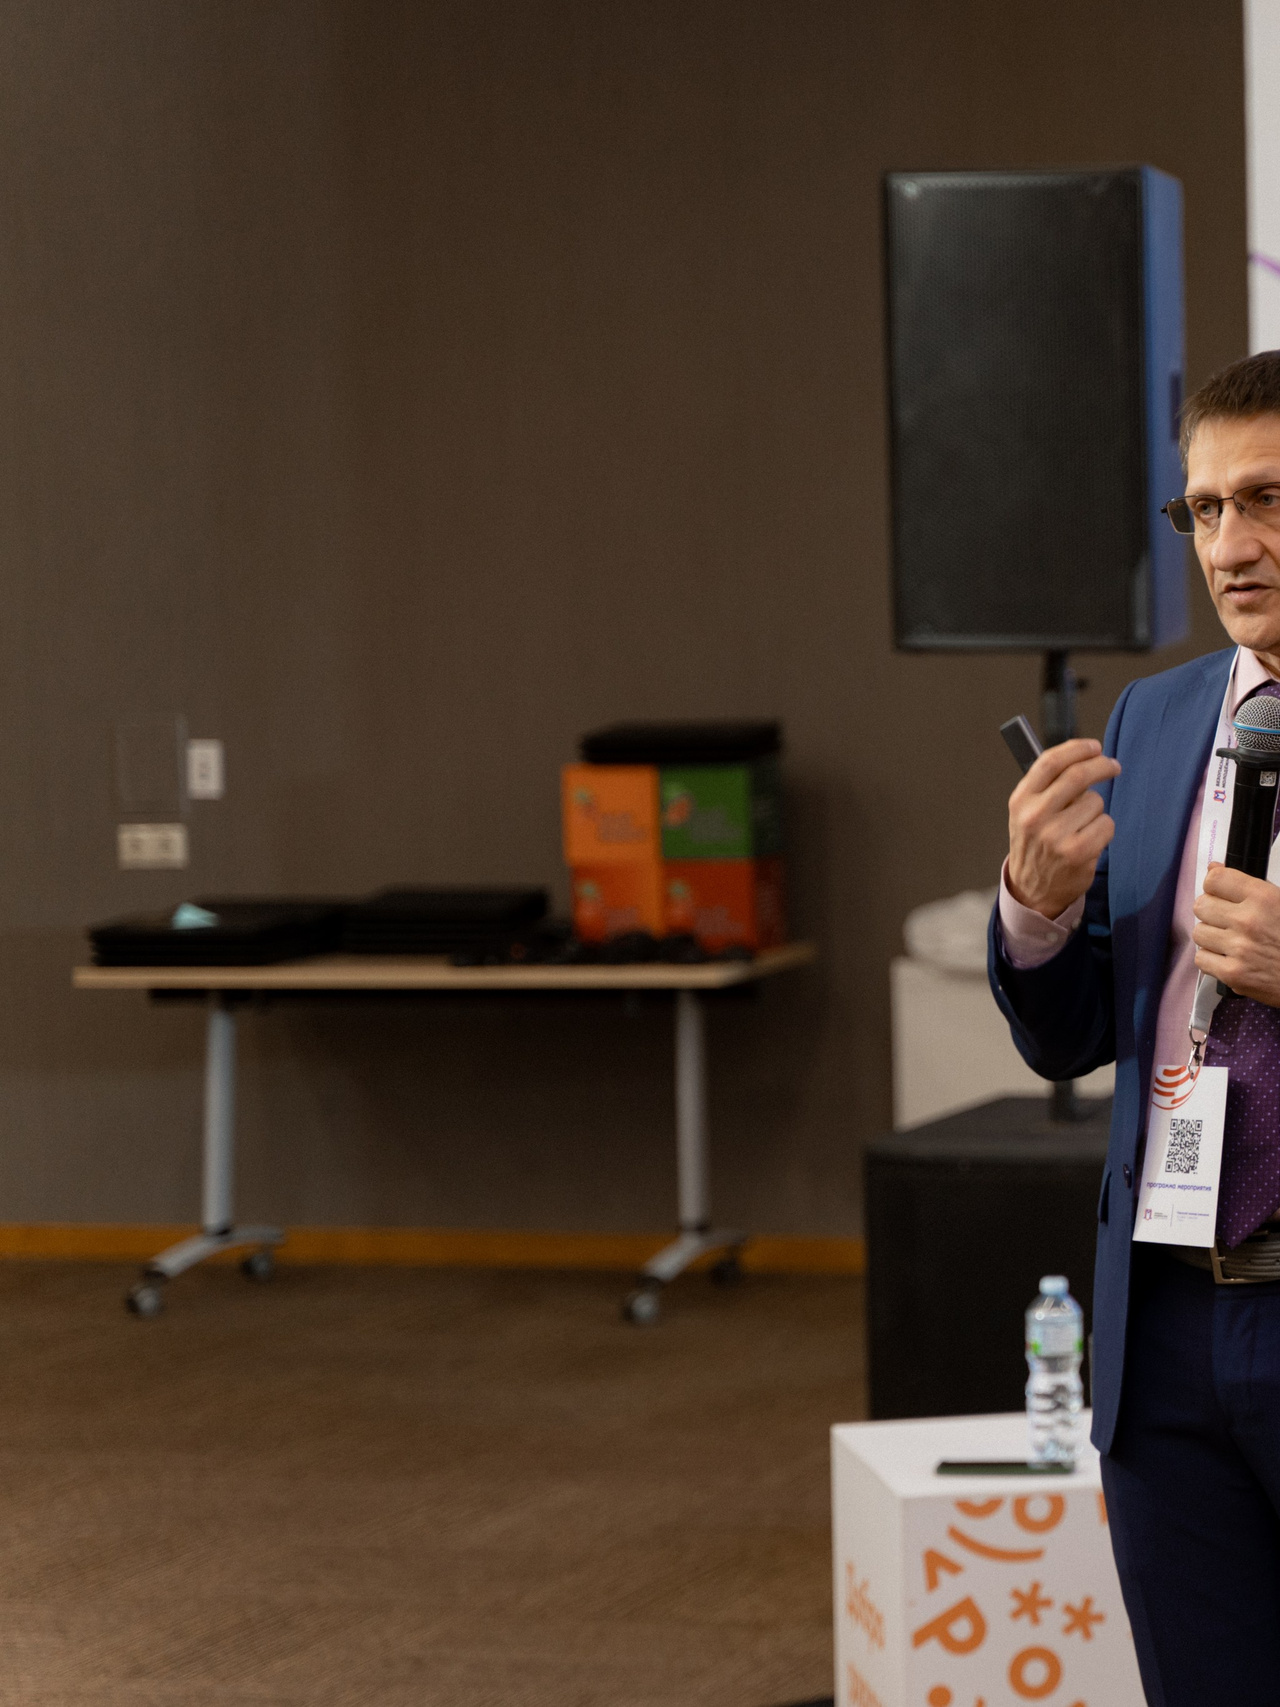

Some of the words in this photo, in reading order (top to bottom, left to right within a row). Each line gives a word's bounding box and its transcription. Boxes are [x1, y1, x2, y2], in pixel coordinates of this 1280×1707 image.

[1208, 820, 1218, 865] осмолодёжь
[1147, 1182, 1176, 1190] программа
[1177, 1184, 1212, 1192] мероприятия
